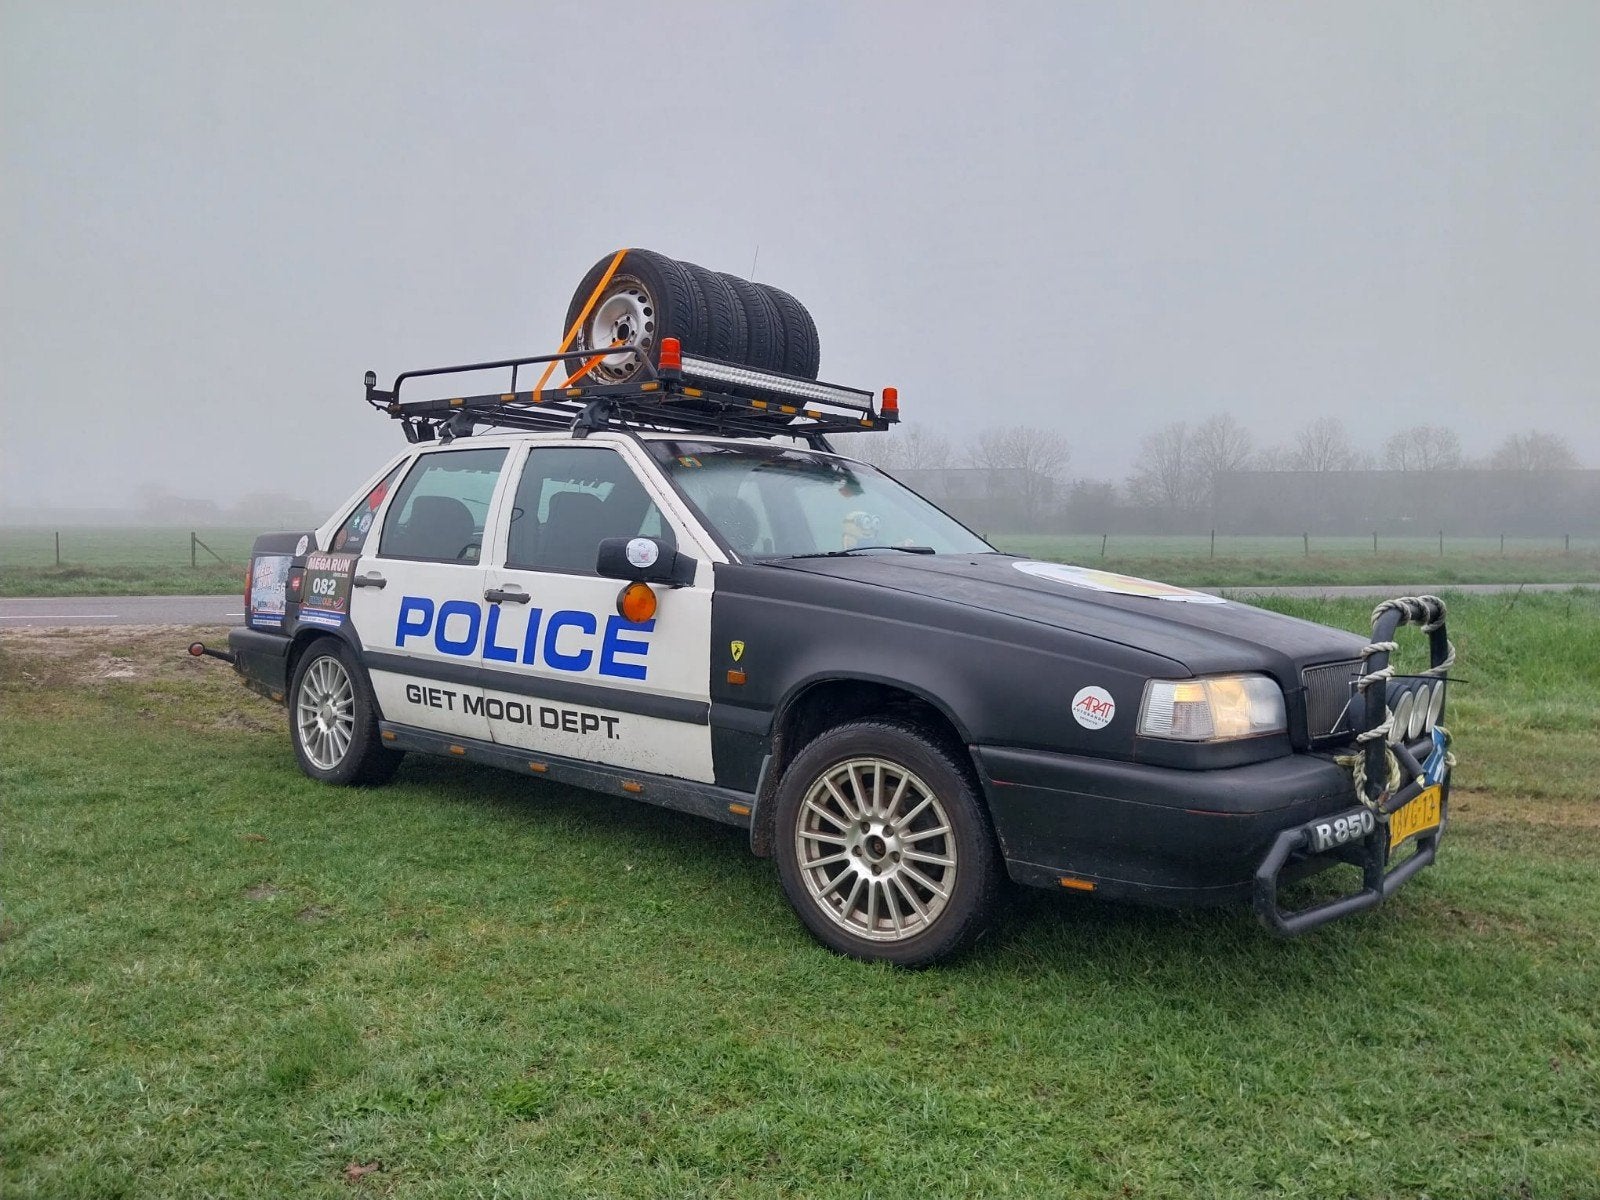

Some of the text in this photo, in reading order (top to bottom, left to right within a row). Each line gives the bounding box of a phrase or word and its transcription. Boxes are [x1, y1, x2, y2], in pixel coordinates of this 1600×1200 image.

[313, 577, 337, 595] 082
[395, 596, 656, 680] POLICE
[406, 684, 620, 740] GIET MOOI DEPT.
[1076, 696, 1114, 718] ARAT
[1316, 809, 1375, 850] R 850
